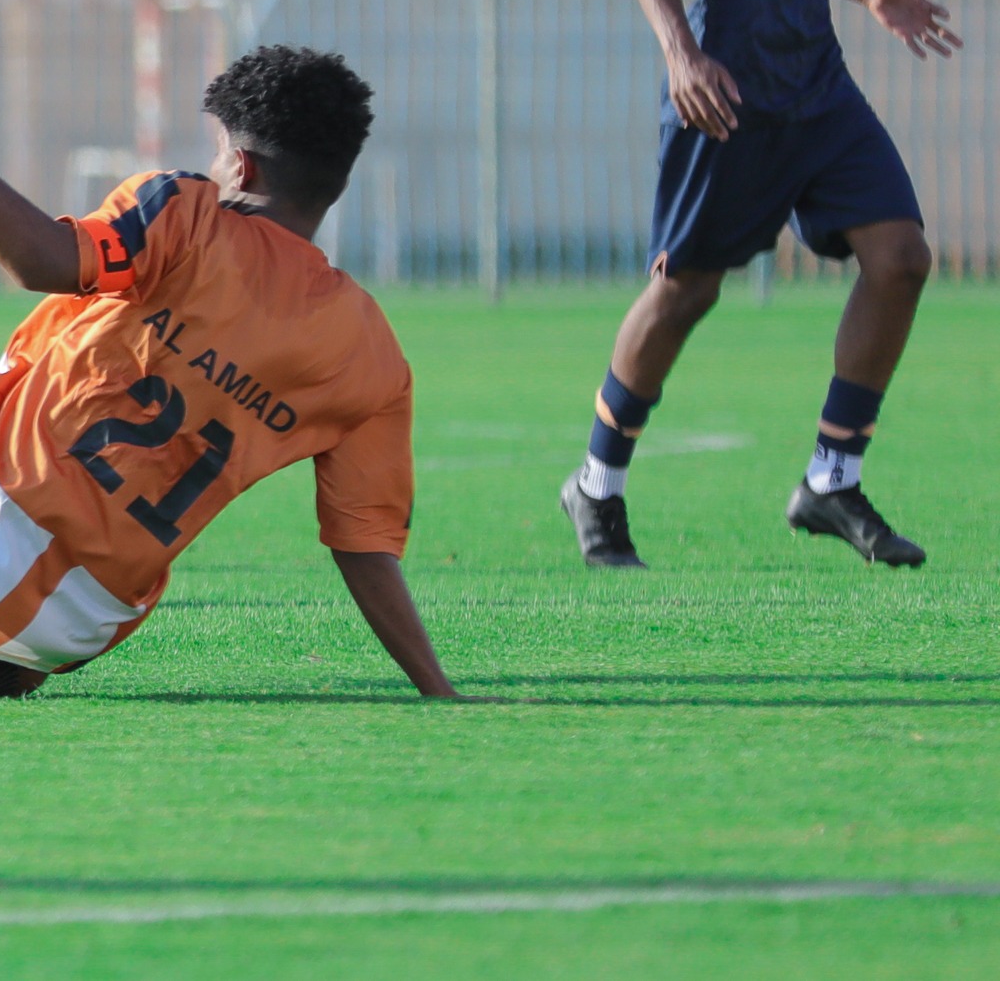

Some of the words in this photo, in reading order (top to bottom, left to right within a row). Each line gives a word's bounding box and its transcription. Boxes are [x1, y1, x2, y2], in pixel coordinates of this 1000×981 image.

[142, 307, 186, 355] AL
[188, 348, 298, 433] AMJAD
[67, 374, 235, 548] 21
